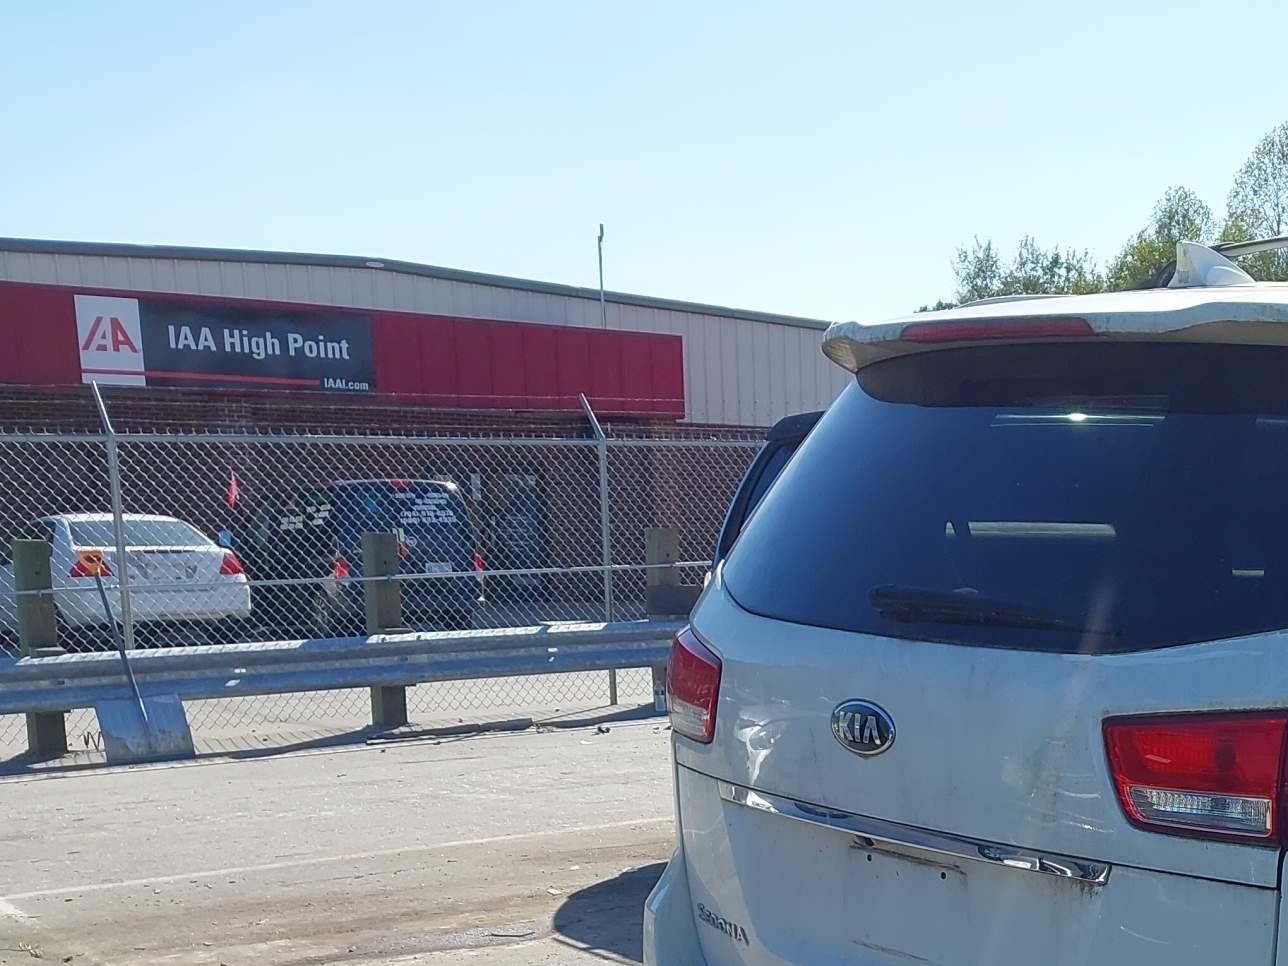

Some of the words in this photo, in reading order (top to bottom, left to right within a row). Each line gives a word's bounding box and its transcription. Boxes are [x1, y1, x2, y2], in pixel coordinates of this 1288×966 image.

[167, 324, 217, 352] IAA
[223, 328, 281, 360] High
[288, 332, 350, 361] Point
[323, 377, 369, 391] IAAI.com
[838, 711, 881, 745] KIA
